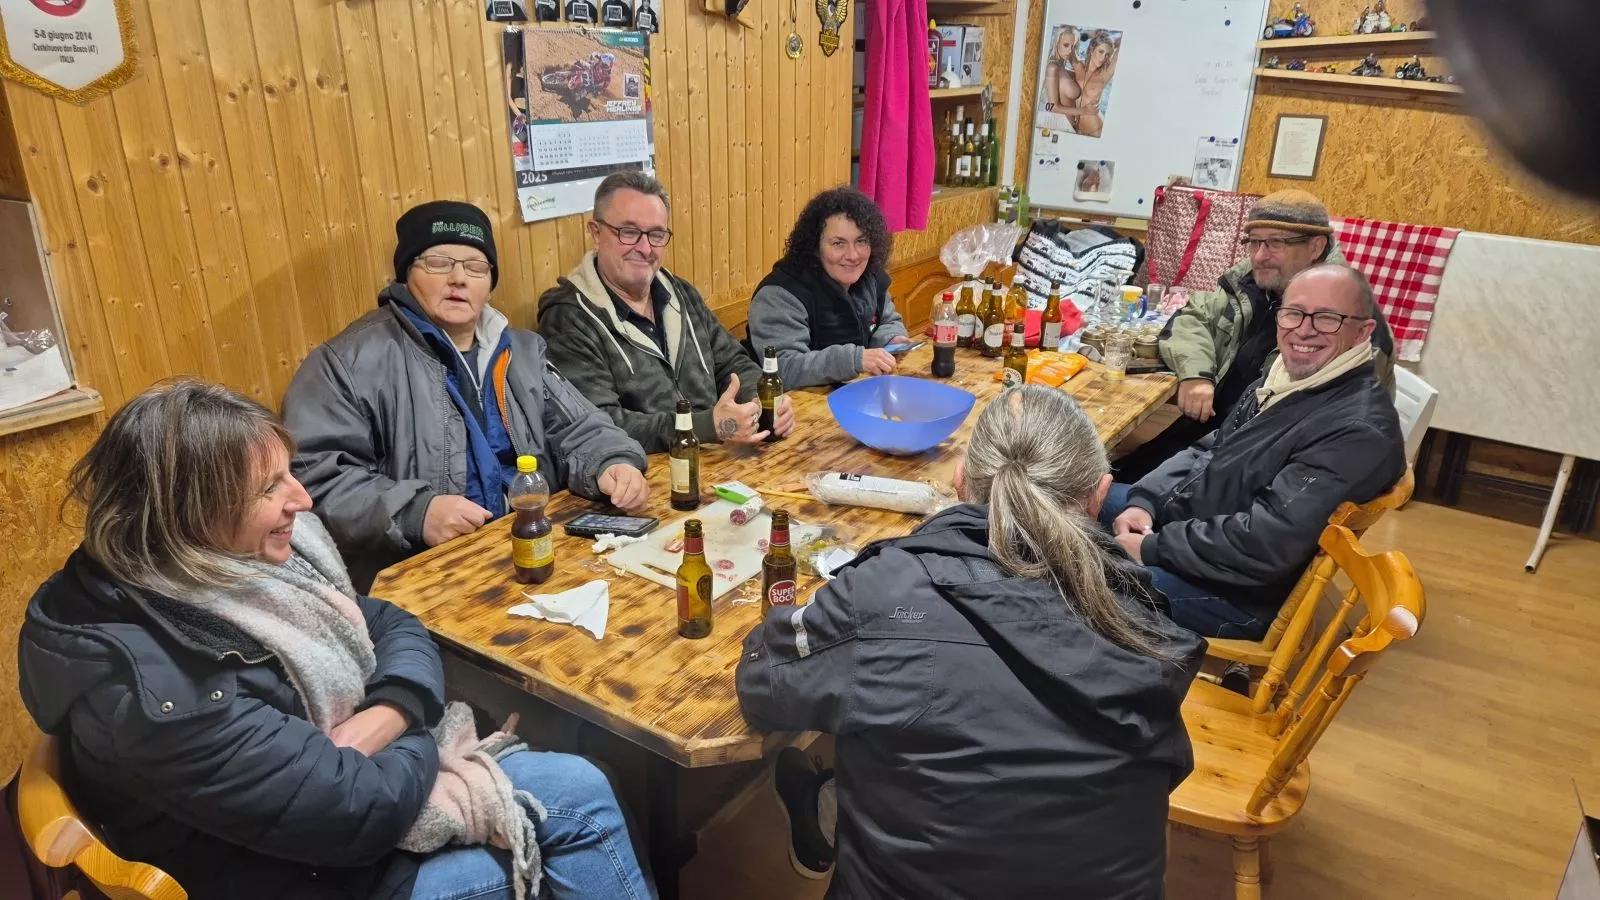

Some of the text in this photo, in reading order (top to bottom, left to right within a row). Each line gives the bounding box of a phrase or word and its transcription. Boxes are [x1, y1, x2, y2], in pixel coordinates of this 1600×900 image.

[33, 29, 92, 42] 5-8 giugno 2014
[59, 55, 75, 63] ITALIA
[1045, 103, 1054, 112] 07
[521, 171, 547, 185] 2025
[771, 586, 794, 596] SUPER
[773, 594, 794, 603] BOCK
